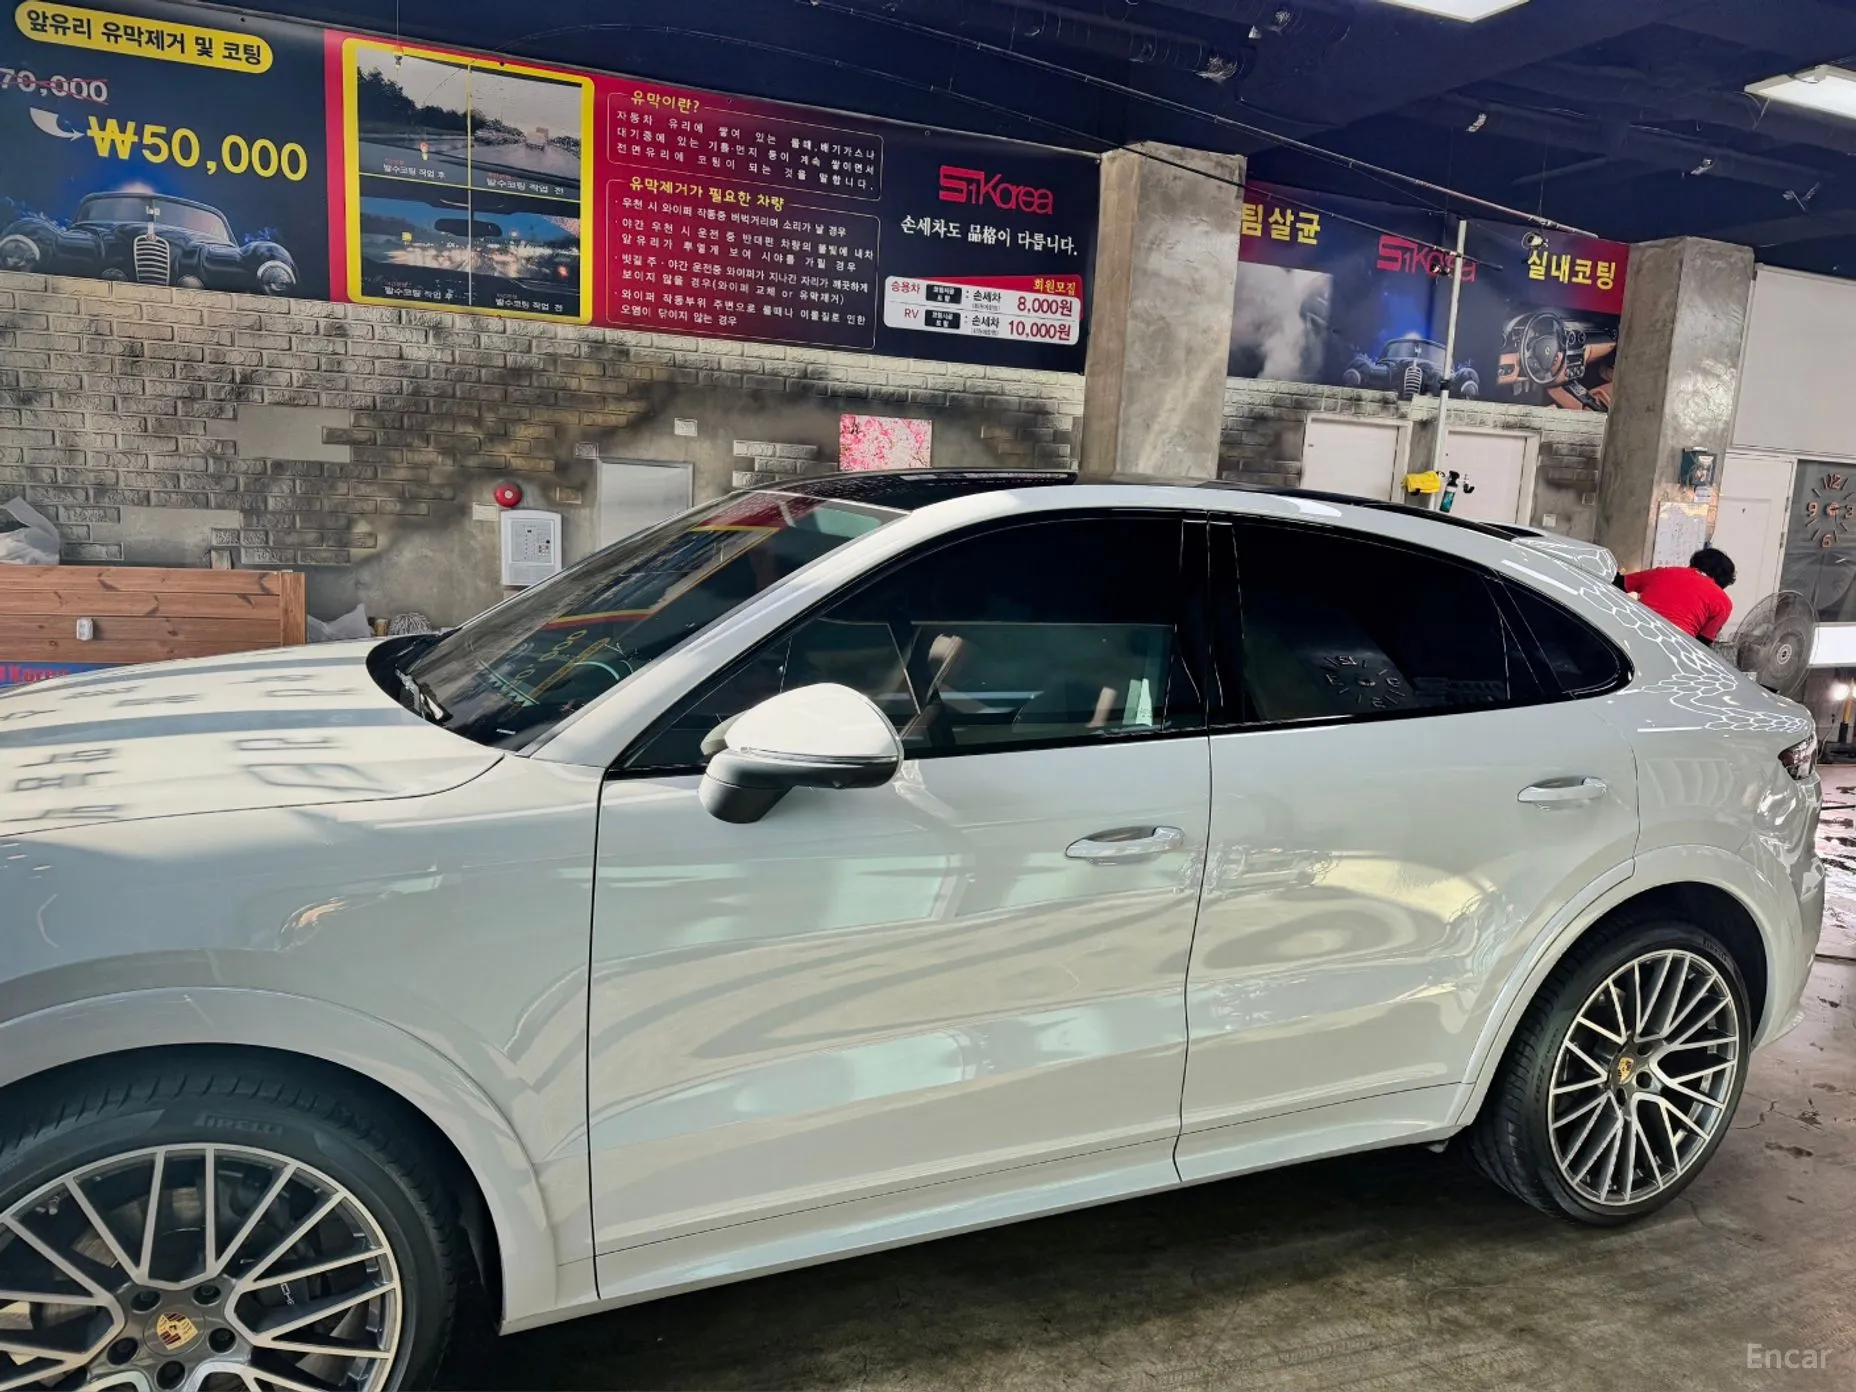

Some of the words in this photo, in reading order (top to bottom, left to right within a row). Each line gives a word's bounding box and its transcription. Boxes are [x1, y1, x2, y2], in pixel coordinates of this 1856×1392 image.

[26, 10, 92, 39] 앞유리
[101, 21, 186, 54] 유막제거
[194, 38, 214, 58] 및
[222, 42, 262, 66] 코팅
[631, 90, 700, 114] 유막이란?
[617, 110, 653, 126] 자동차
[669, 118, 703, 133] 유리에
[755, 132, 776, 145] 있는
[617, 127, 665, 143] 대기중에
[677, 136, 699, 149] 있는
[87, 115, 308, 181] ₩50,000
[697, 155, 735, 170] 코팅이
[749, 162, 771, 175] 되는
[785, 167, 806, 180] 것을
[630, 176, 703, 198] 유막제거가
[708, 187, 751, 206] 필요한
[757, 194, 784, 212] 차량
[622, 197, 643, 209] 우천
[647, 202, 657, 212] 시
[662, 203, 692, 216] 와이퍼
[697, 208, 727, 221] 작동중
[730, 212, 778, 229] 버벅거리며
[783, 220, 811, 232] 소리가
[828, 226, 847, 238] 경우
[1241, 202, 1320, 245] 팀살균
[622, 218, 644, 231] 야간
[652, 221, 673, 234] 우천
[681, 226, 690, 236] 시
[697, 227, 719, 240] 운전
[726, 231, 735, 242] 중
[742, 233, 774, 248] 반대편
[781, 238, 811, 252] 차량의
[900, 214, 962, 238] 손세차도
[968, 224, 1011, 247] 品格이
[1017, 230, 1078, 256] 다릅니다.
[692, 262, 722, 275] 운전중
[726, 266, 765, 280] 와이퍼가
[769, 272, 797, 284] 지나간
[800, 276, 828, 288] 자리가
[836, 261, 856, 272] 경우
[1528, 249, 1616, 290] 실내코팅
[622, 269, 655, 283] 보이지
[756, 285, 776, 297] 교체
[781, 290, 793, 298] or
[890, 281, 920, 294] 승용차
[1033, 277, 1076, 296] 회원모집
[621, 289, 655, 302] 와이퍼
[662, 293, 706, 309] 작동부위
[973, 290, 1001, 303] 손세차
[1017, 296, 1073, 317] 8,000원
[620, 304, 651, 317] 오염이
[693, 312, 712, 324] 않는
[718, 314, 737, 327] 경우
[904, 308, 919, 319] RV
[971, 315, 999, 328] 손세차
[1008, 320, 1071, 341] 10,000원
[1807, 501, 1818, 517] 9
[1821, 534, 1832, 548] 6
